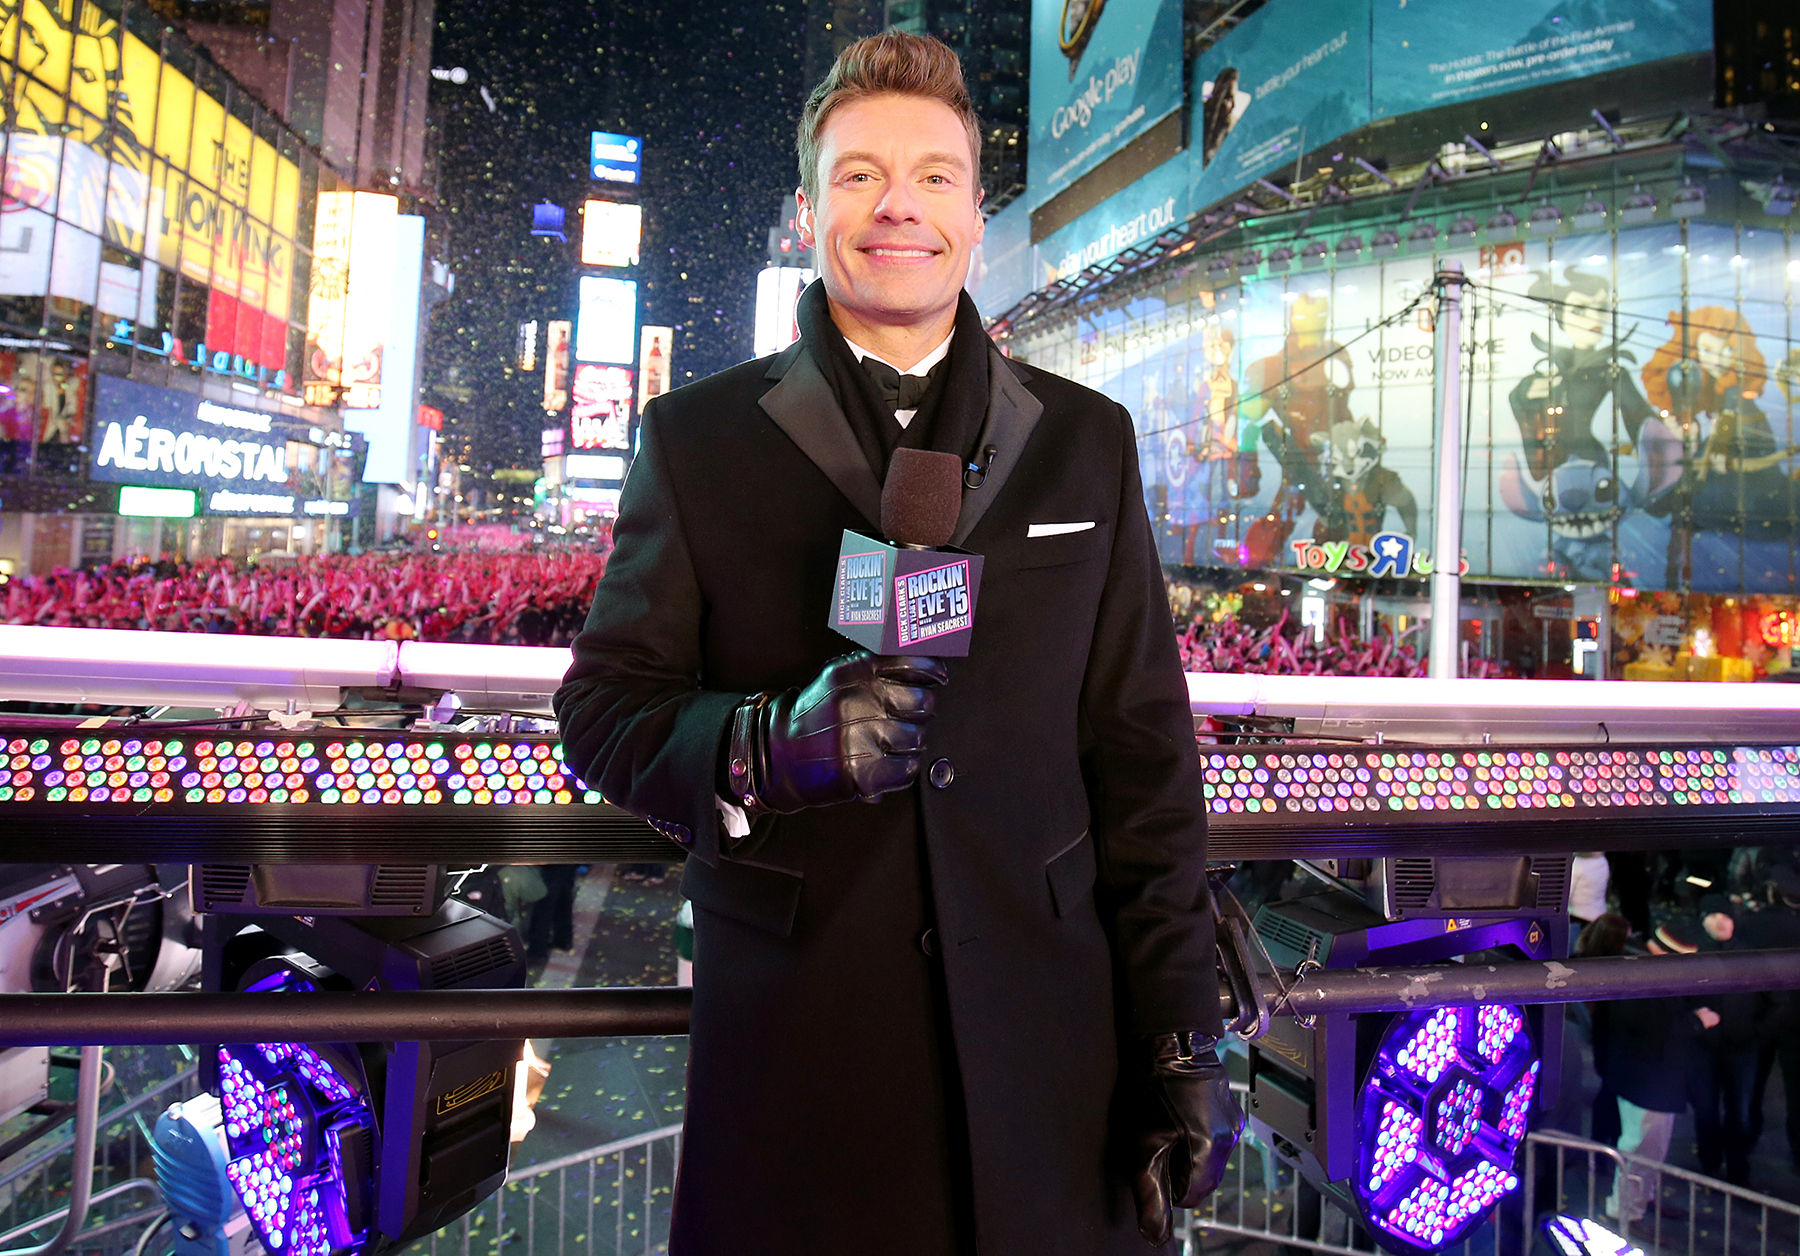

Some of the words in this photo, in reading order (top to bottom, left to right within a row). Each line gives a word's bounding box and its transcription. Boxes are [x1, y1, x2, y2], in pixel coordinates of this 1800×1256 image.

[1301, 43, 1329, 70] heart
[1329, 31, 1348, 53] out
[1429, 63, 1448, 73] The
[1485, 50, 1505, 61] The
[1507, 42, 1537, 57] Battle
[1550, 36, 1569, 48] the
[1571, 30, 1593, 41] Five
[1594, 20, 1635, 36] Armies
[1456, 63, 1498, 79] theaters
[1580, 38, 1614, 54] today
[1052, 76, 1103, 139] Google
[1105, 47, 1141, 103] play
[212, 138, 250, 189] THE
[1111, 223, 1147, 251] heart
[1148, 196, 1176, 232] out
[1368, 344, 1433, 364] VIDEO
[1372, 367, 1409, 380] NOW
[847, 554, 884, 579] ROCKIN'
[908, 564, 965, 599] ROCKIN'
[851, 579, 868, 601] EVE
[898, 580, 907, 617] CLARK'S
[917, 592, 946, 618] EVE
[910, 623, 918, 639] NEW
[921, 624, 937, 638] RYAN
[937, 615, 968, 632] SEACREST
